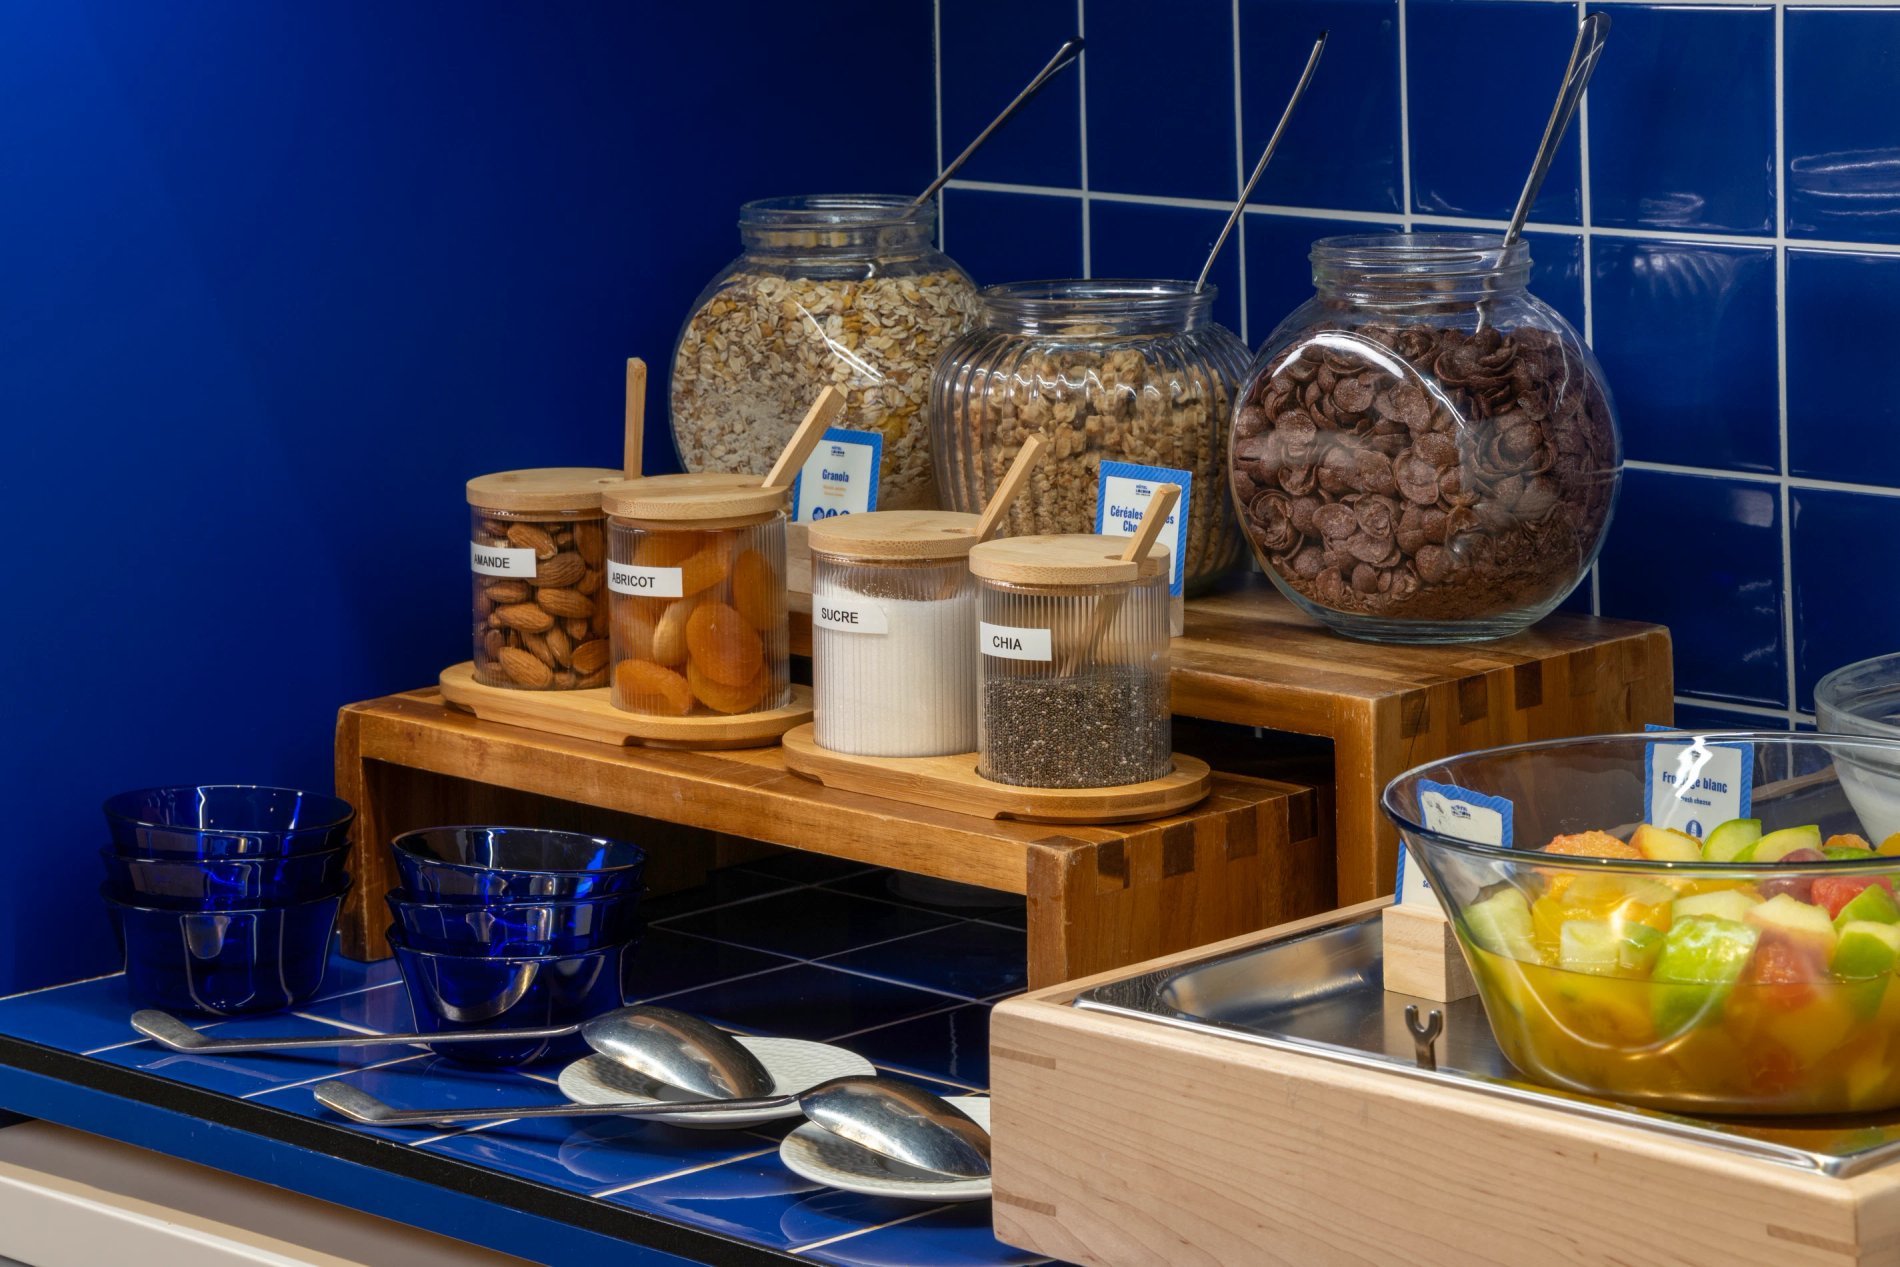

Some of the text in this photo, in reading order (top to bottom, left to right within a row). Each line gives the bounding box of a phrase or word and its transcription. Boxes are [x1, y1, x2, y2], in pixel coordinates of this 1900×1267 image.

[822, 469, 849, 483] Granola
[1110, 505, 1143, 520] Céréales
[474, 555, 511, 569] AMANDE
[612, 572, 656, 589] ABRICOT
[821, 607, 859, 625] SUCRE
[992, 635, 1023, 651] CHIA
[1703, 777, 1728, 794] blanc
